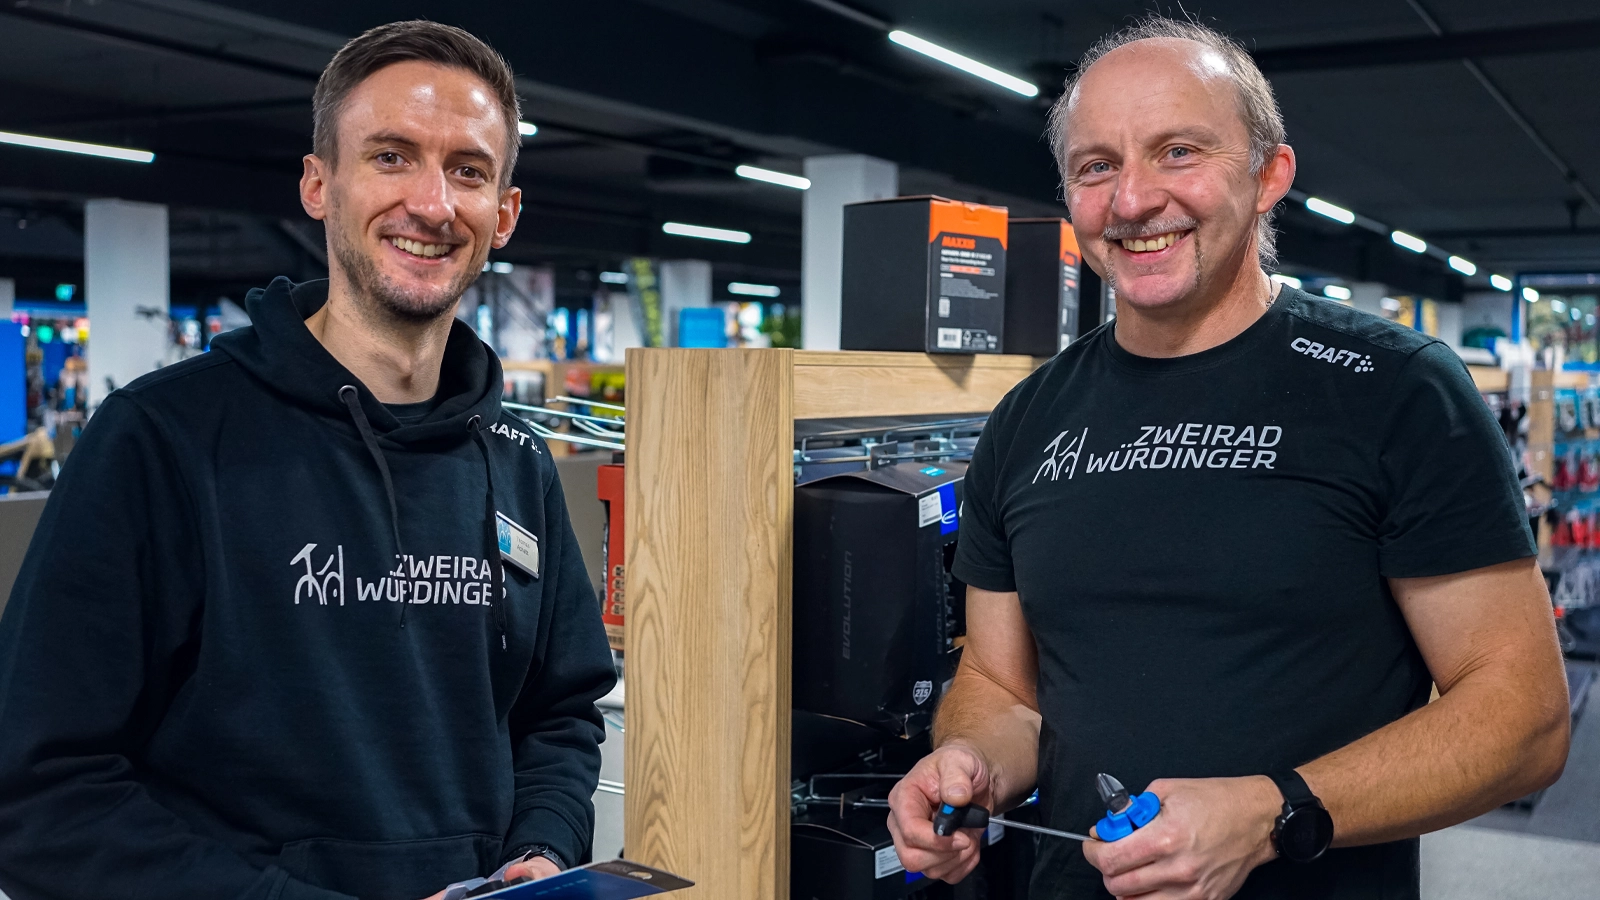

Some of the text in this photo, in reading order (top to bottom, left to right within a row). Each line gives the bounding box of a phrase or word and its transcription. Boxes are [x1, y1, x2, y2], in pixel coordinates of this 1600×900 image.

[1290, 337, 1360, 368] CRAFT
[1134, 422, 1283, 447] ZWEIRAD
[1086, 442, 1278, 474] WÜRDINGER
[395, 554, 506, 583] ZWEIRA
[356, 570, 507, 607] WÜRDINGE
[842, 550, 853, 660] EVOLUTION
